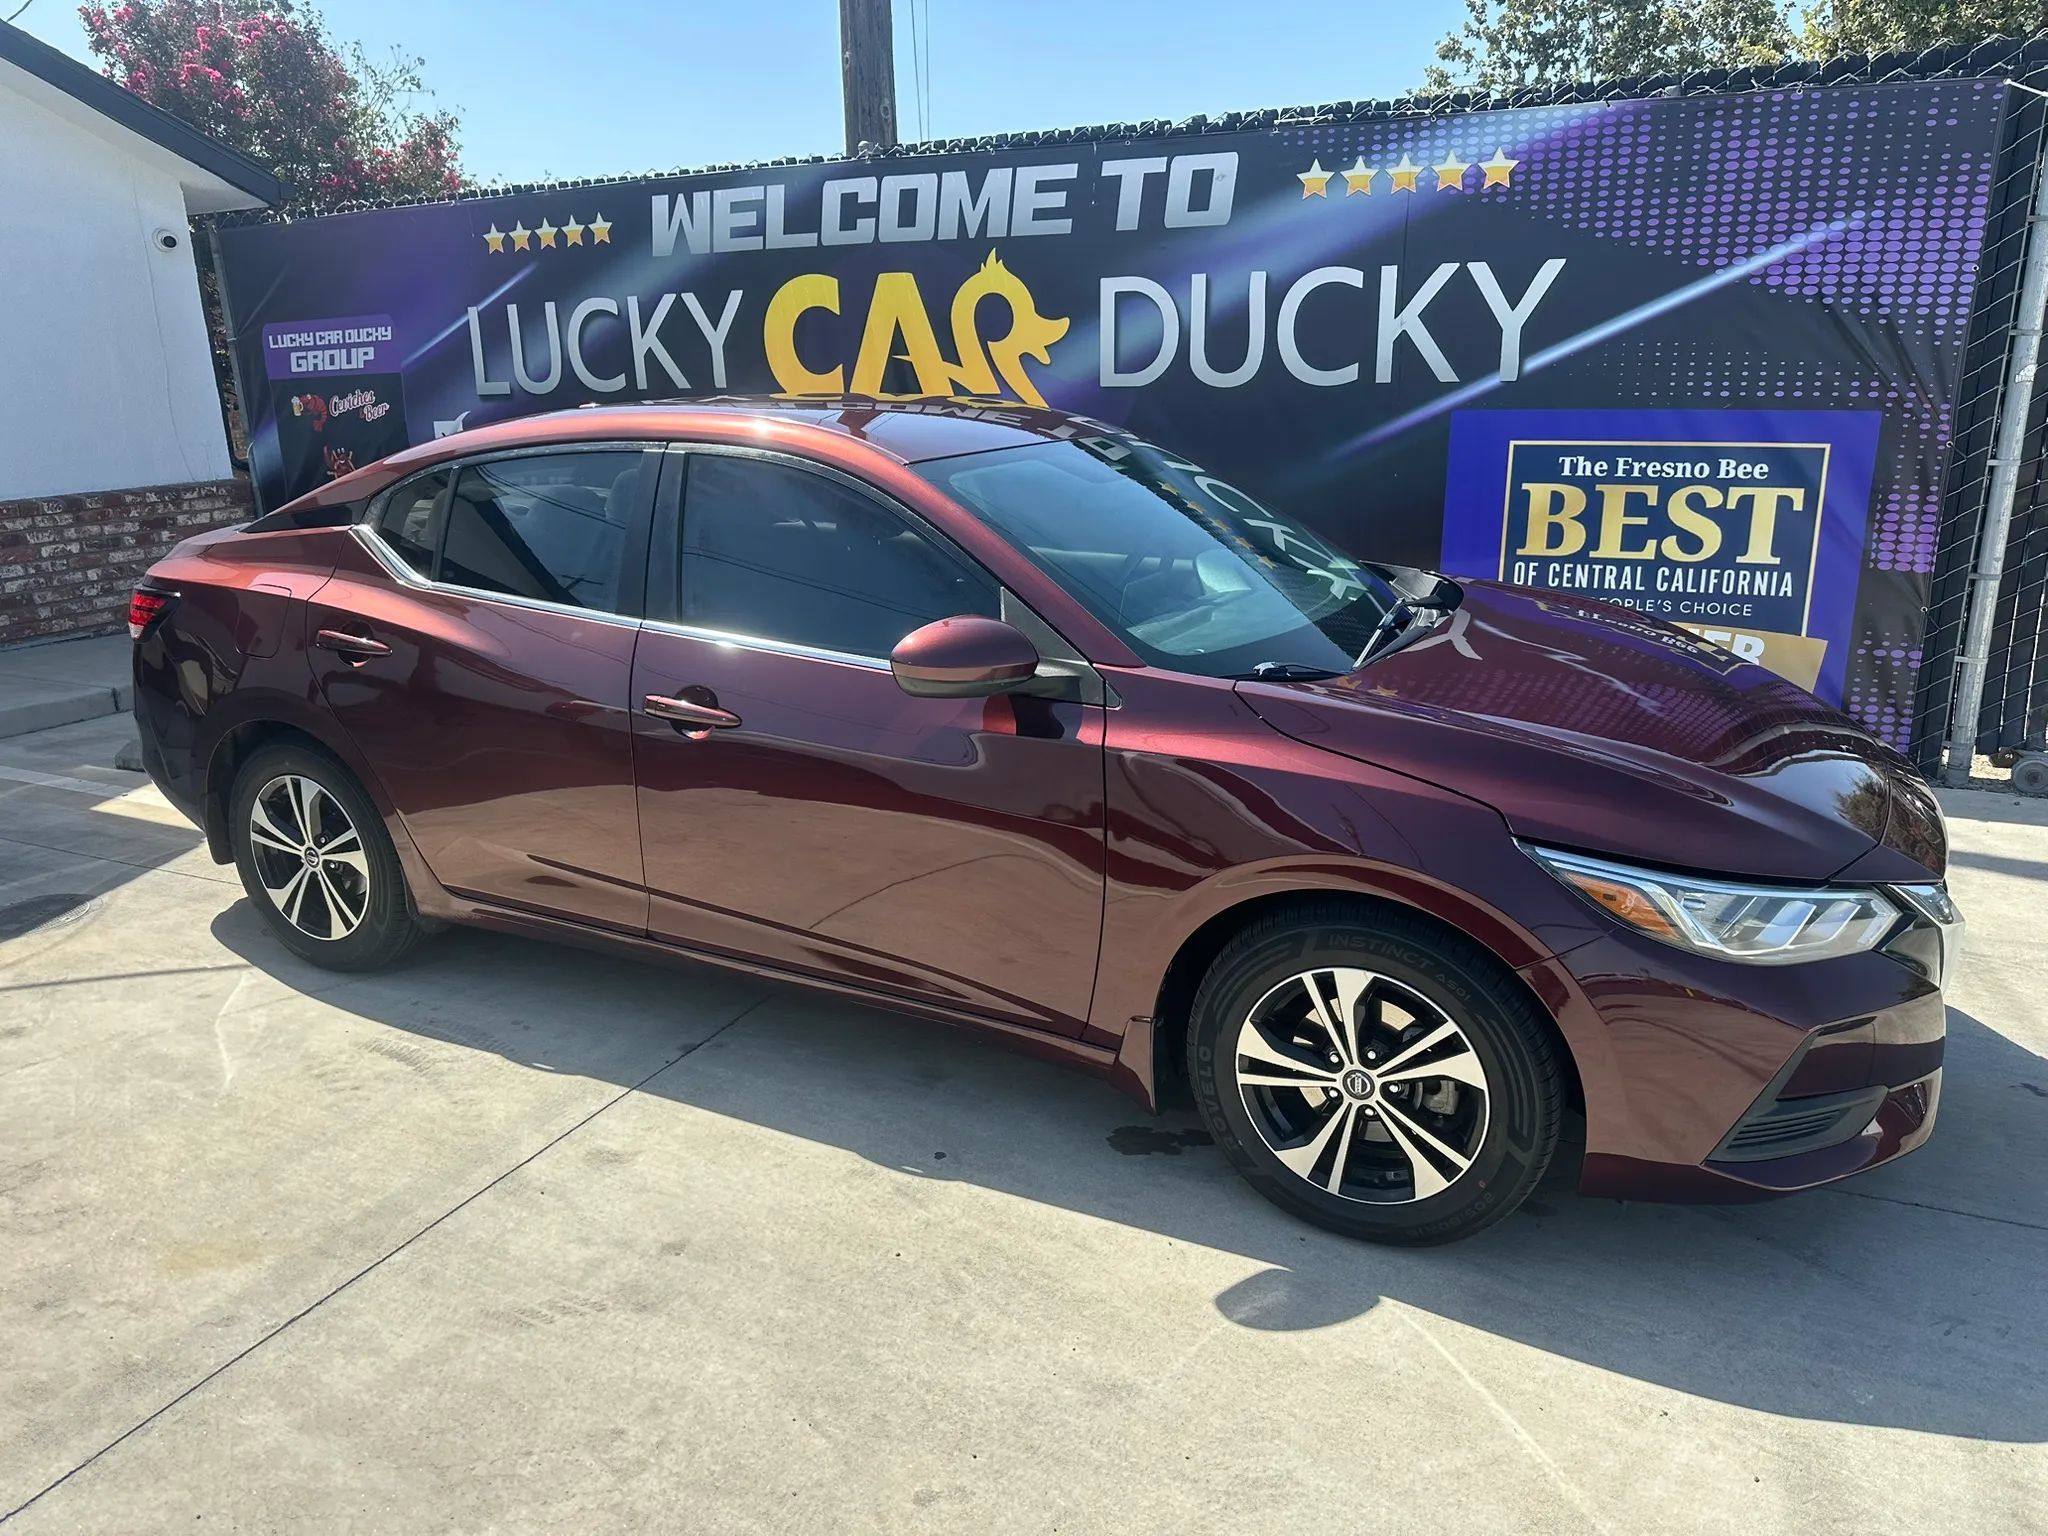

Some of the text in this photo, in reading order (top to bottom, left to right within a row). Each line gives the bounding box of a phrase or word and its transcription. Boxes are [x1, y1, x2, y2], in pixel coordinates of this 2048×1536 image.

[651, 151, 1239, 257] WELCOME TO
[269, 326, 392, 349] LUCKY CAR DUCKY
[467, 247, 1567, 411] LUCKY CAR DUCKY
[290, 347, 374, 373] GROUP
[329, 389, 376, 417] Ceviches
[364, 403, 390, 422] Beer
[1559, 456, 1769, 480] The Fresno Bee
[1516, 483, 1805, 565] BEST
[1514, 561, 1793, 597] OF CENTRAL CALIFORNIA
[1591, 597, 1752, 616] OPLE'S CHOICE
[1328, 933, 1435, 969] INSTINCT
[1199, 1046, 1237, 1151] ROVELO
